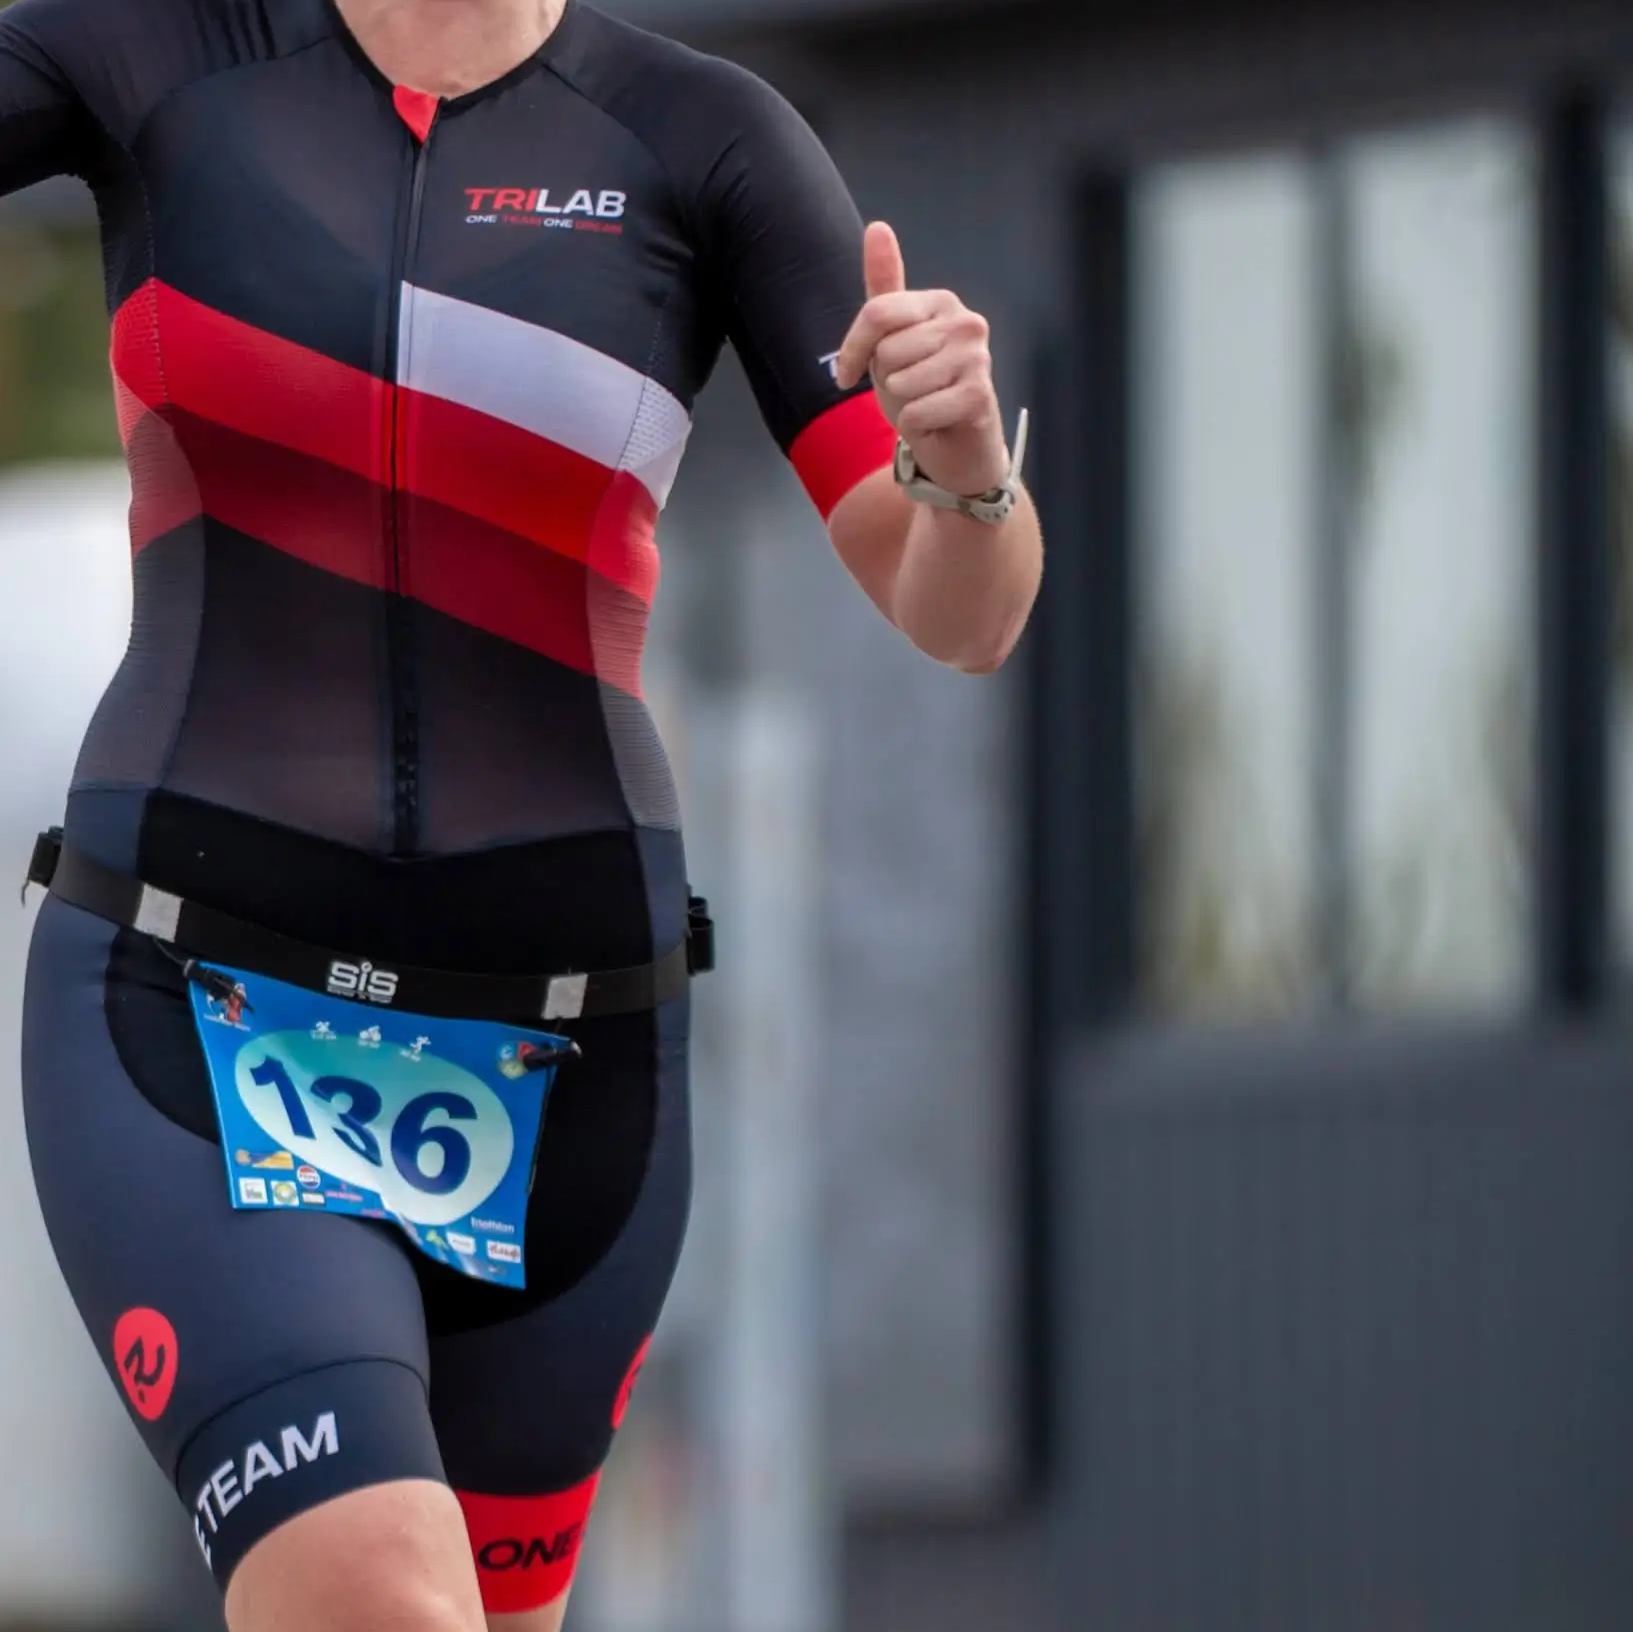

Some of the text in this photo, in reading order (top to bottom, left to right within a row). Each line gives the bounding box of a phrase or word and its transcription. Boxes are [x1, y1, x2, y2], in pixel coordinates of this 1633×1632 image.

[463, 187, 627, 218] TRILAB
[465, 214, 498, 224] ONE
[543, 217, 573, 229] ONE
[249, 1057, 478, 1195] 136
[197, 1410, 340, 1533] TEAM
